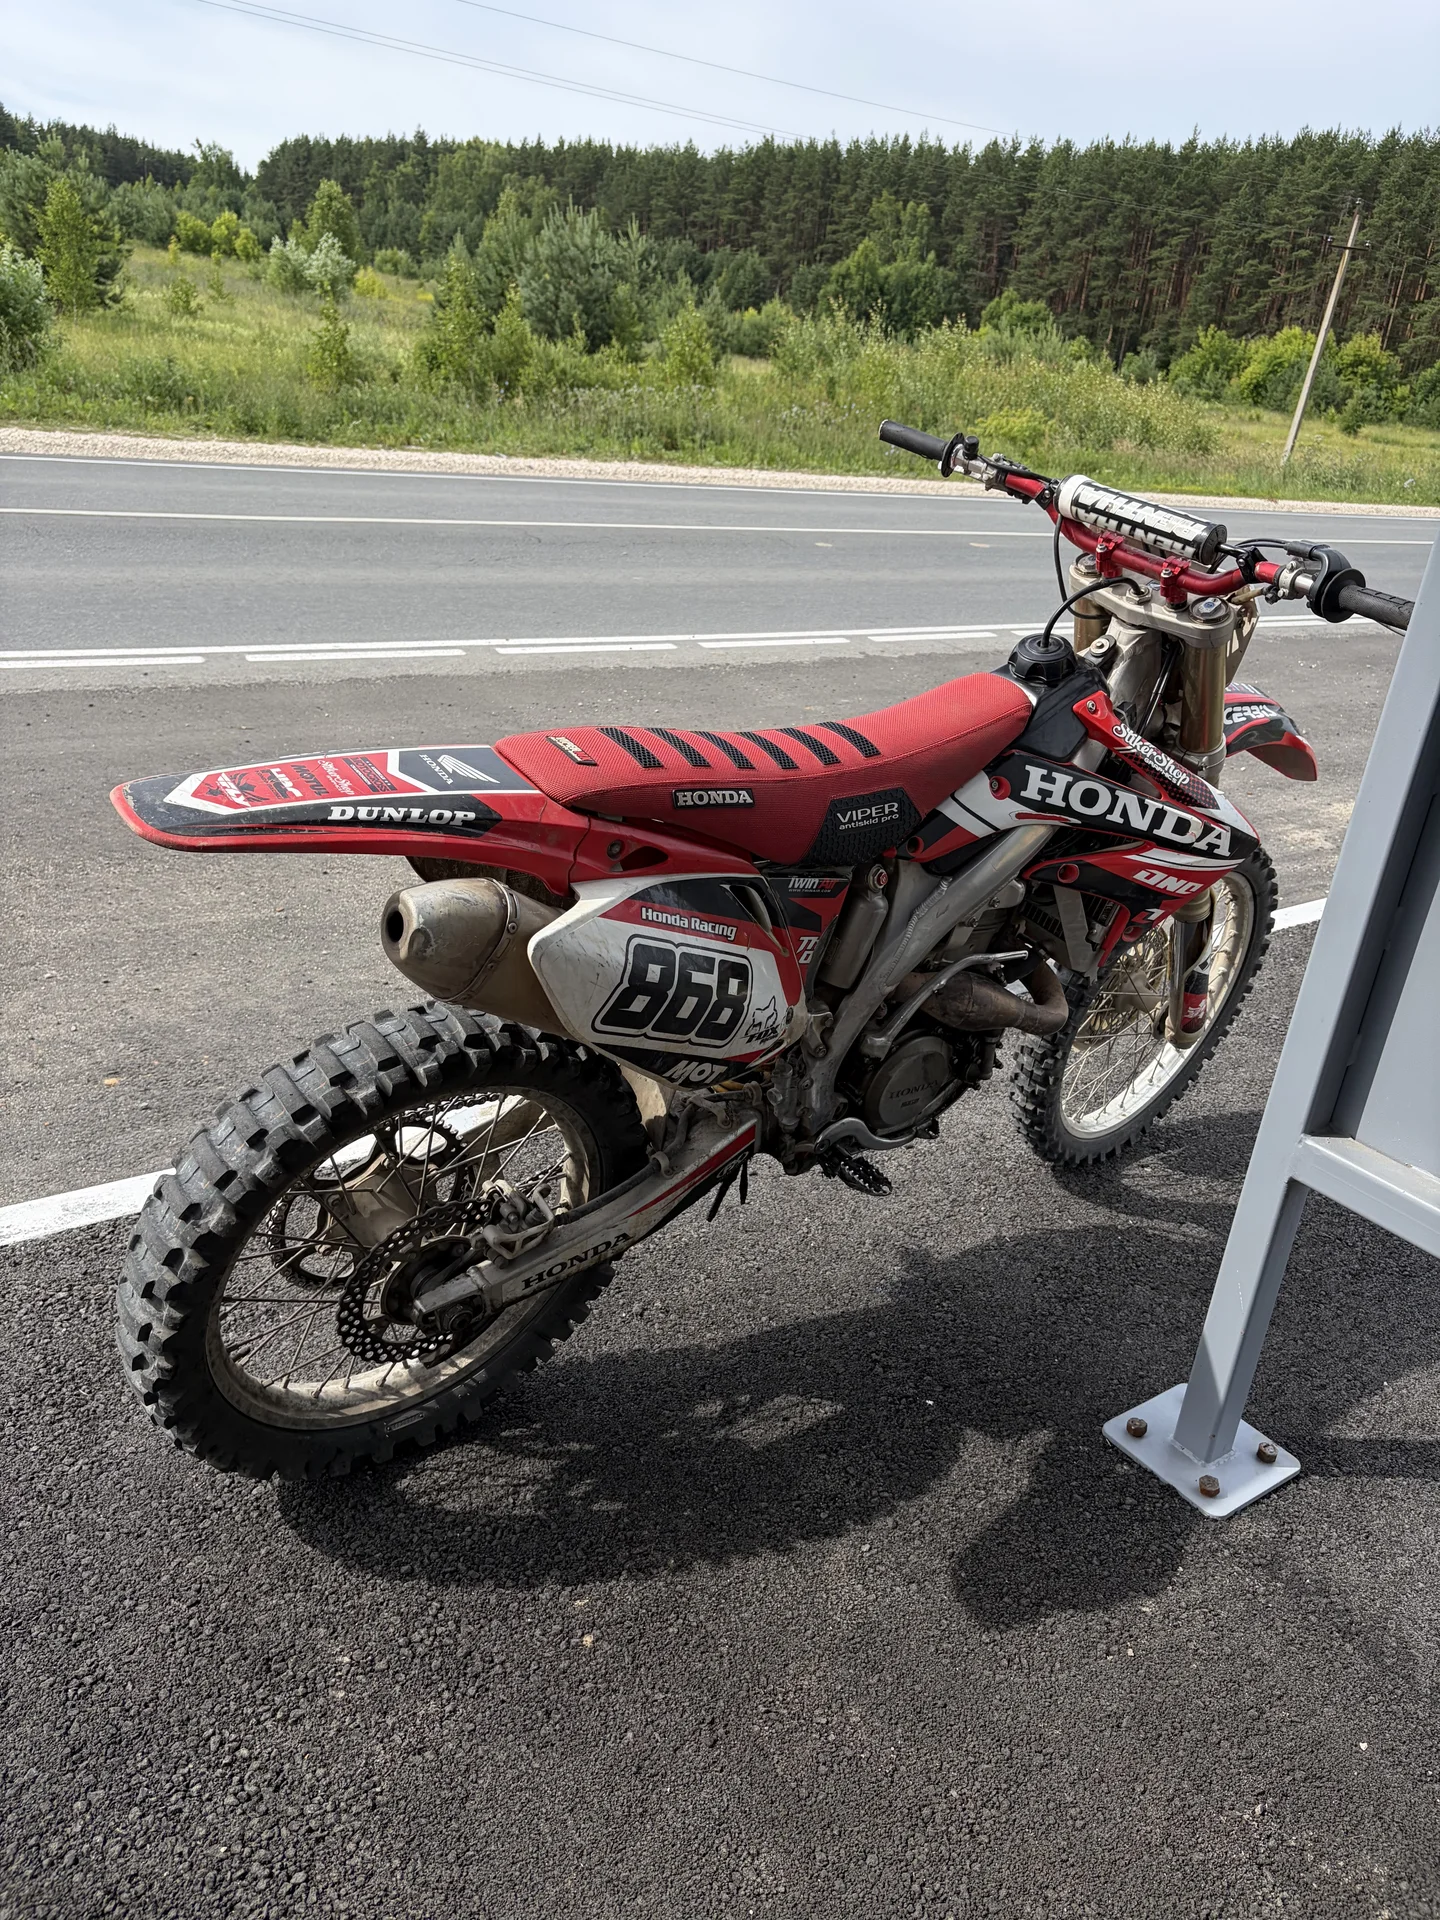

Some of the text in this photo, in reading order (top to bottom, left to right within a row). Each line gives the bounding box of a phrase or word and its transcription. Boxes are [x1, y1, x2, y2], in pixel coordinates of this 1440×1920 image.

[1223, 704, 1277, 725] CERBIS
[418, 754, 454, 785] HONDA
[1143, 757, 1178, 785] GRAPHICS
[676, 790, 754, 807] HONDA
[1019, 764, 1232, 857] HONDA
[327, 806, 476, 826] DUNLOP
[836, 802, 899, 823] VIPER
[839, 813, 900, 830] antiskid pro
[640, 906, 738, 941] Honda Racing
[599, 942, 751, 1041] 868
[888, 1080, 940, 1099] HONDA
[521, 1232, 634, 1291] HONDA
